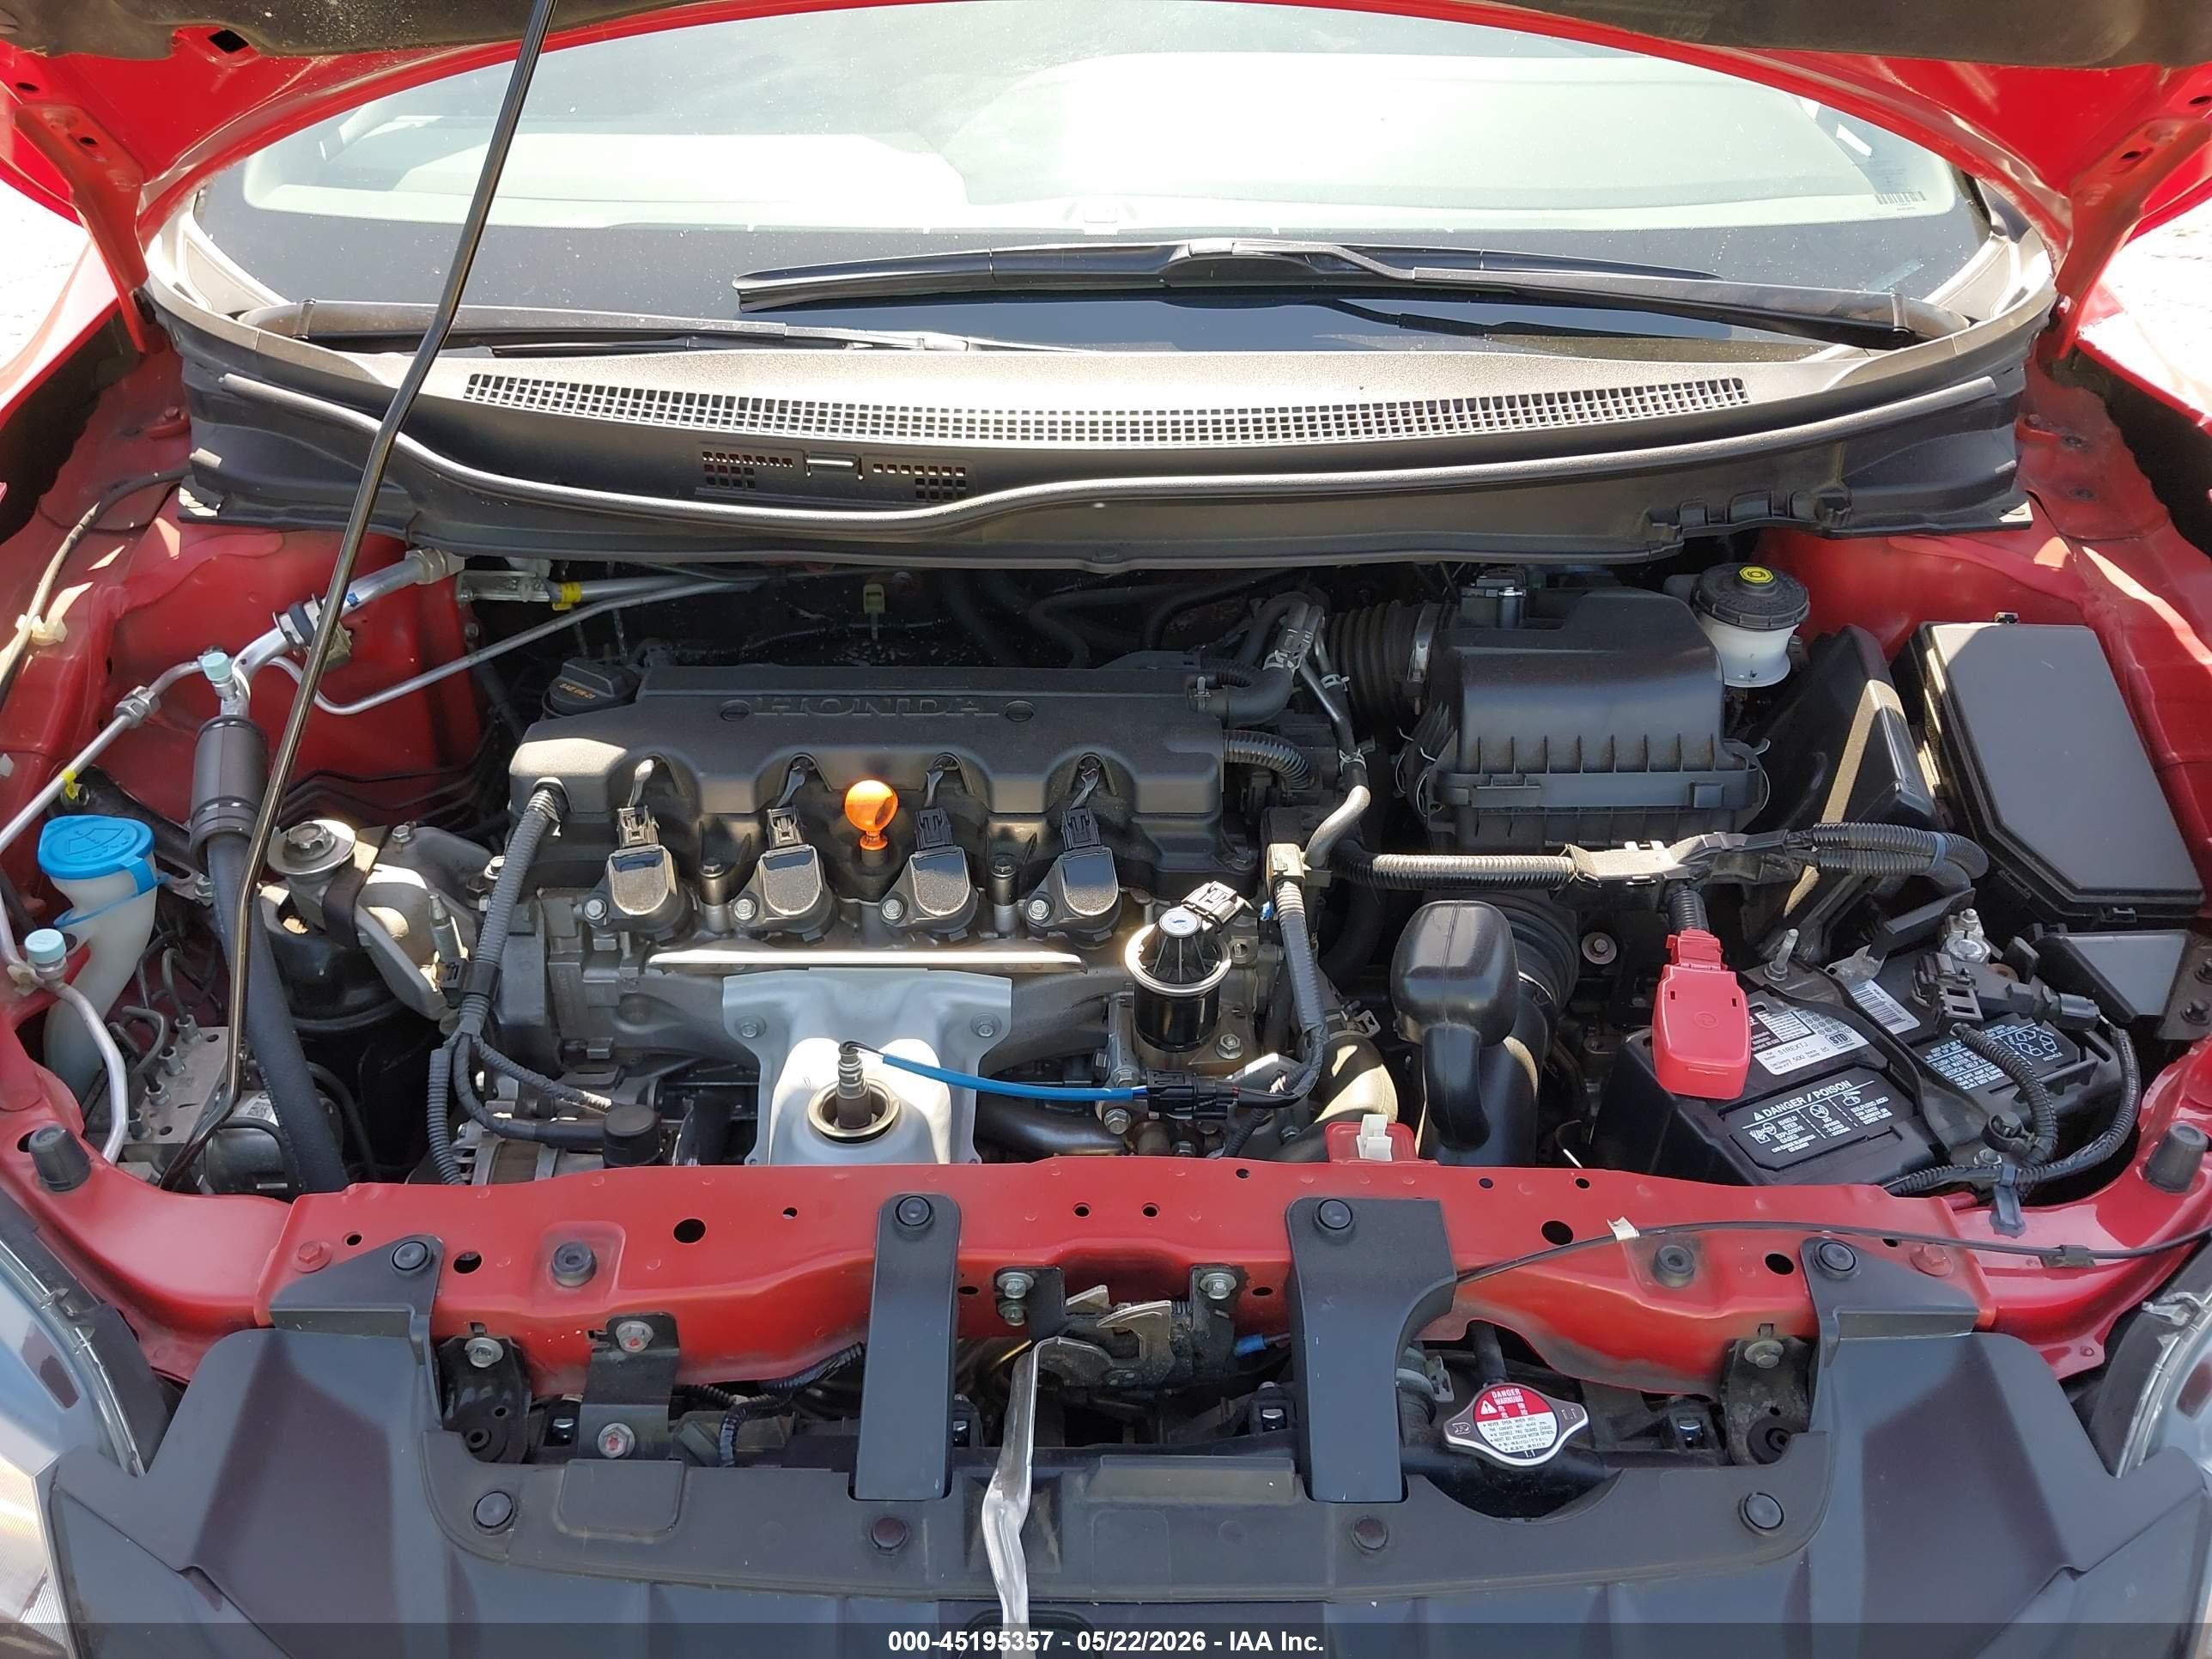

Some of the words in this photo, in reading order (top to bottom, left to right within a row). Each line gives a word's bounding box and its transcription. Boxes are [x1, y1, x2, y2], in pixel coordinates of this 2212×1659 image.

[754, 696, 1000, 716] HONDA
[1829, 1033, 1850, 1045] STD
[1762, 1097, 1807, 1118] DANGER
[1812, 1080, 1853, 1099] POISON
[1492, 1388, 1522, 1399] DANGER
[1525, 1449, 1536, 1458] 1.1
